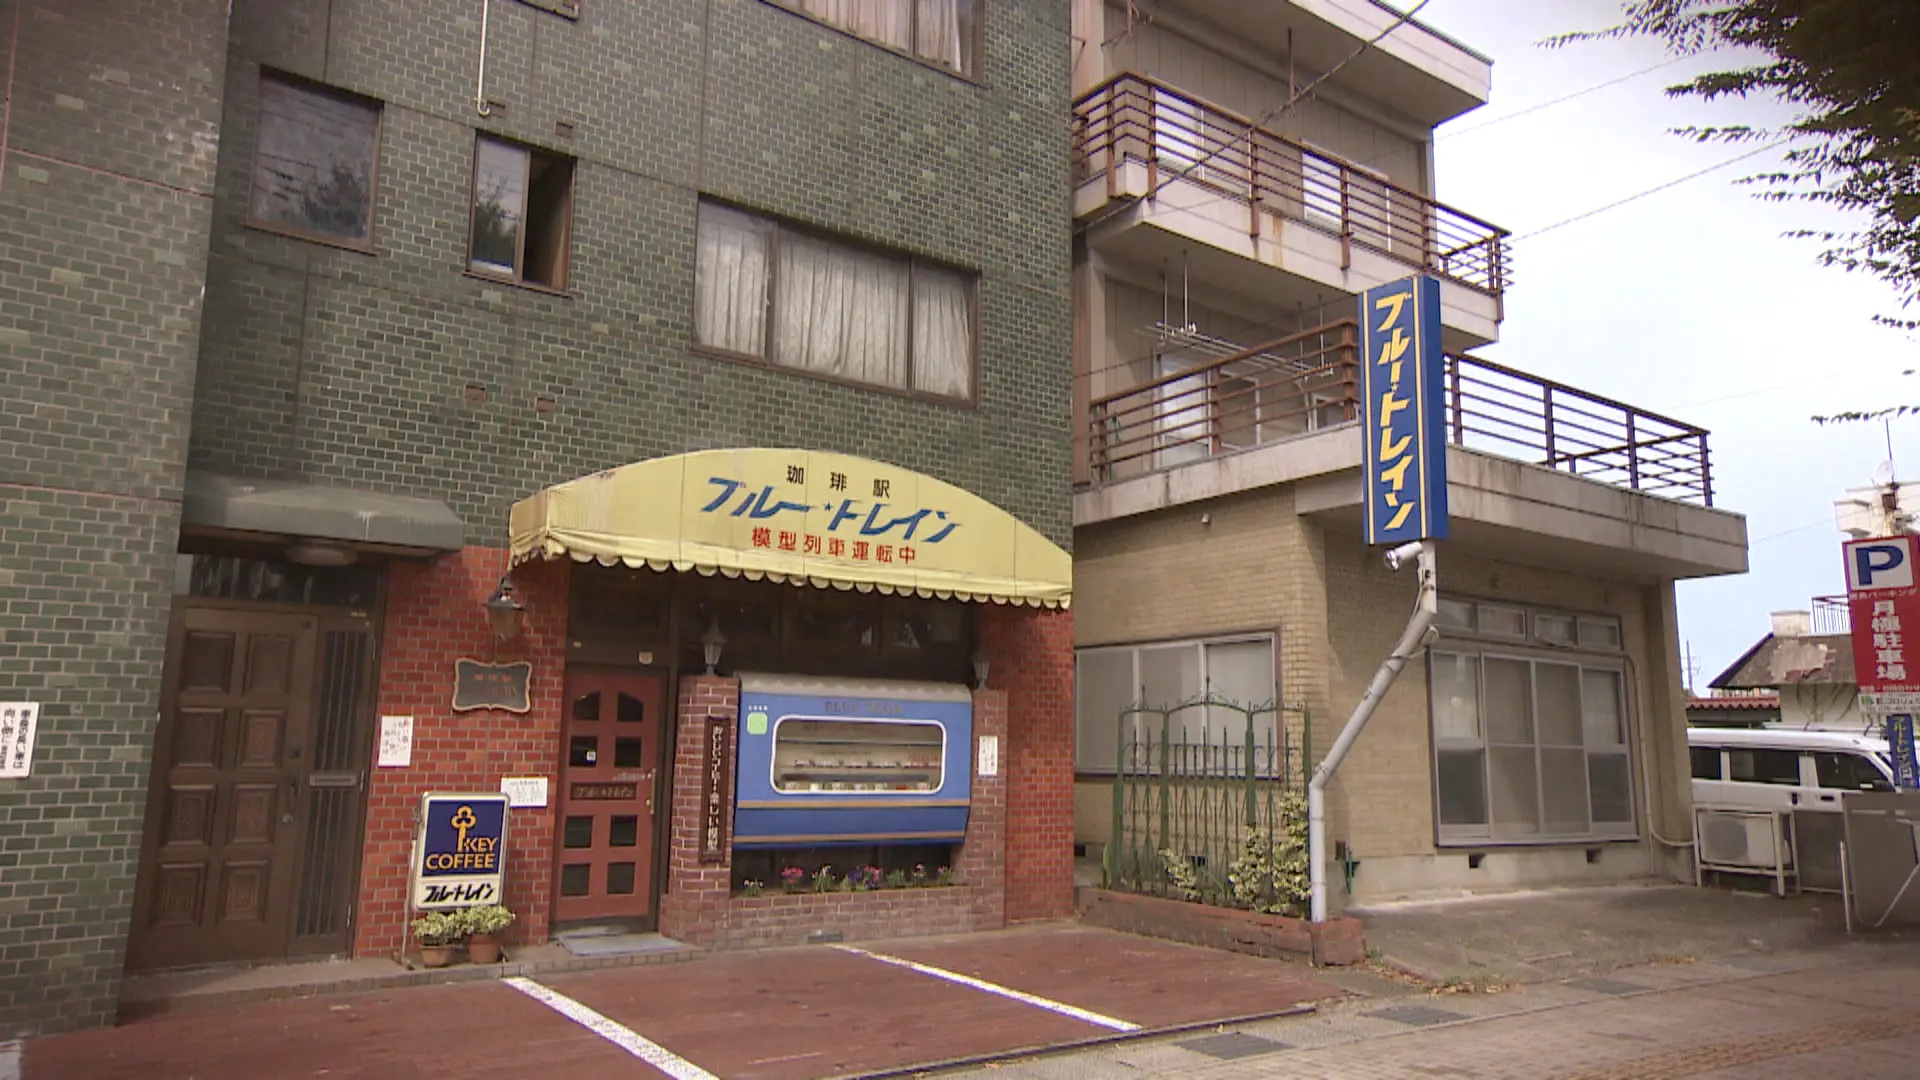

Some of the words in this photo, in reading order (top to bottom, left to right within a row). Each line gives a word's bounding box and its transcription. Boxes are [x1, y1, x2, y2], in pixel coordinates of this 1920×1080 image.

[786, 465, 890, 498] 珈琲駅
[751, 526, 917, 565] 模型列車運転中
[1855, 545, 1904, 586] P
[425, 853, 496, 870] COFFEE
[463, 837, 498, 853] KEY
